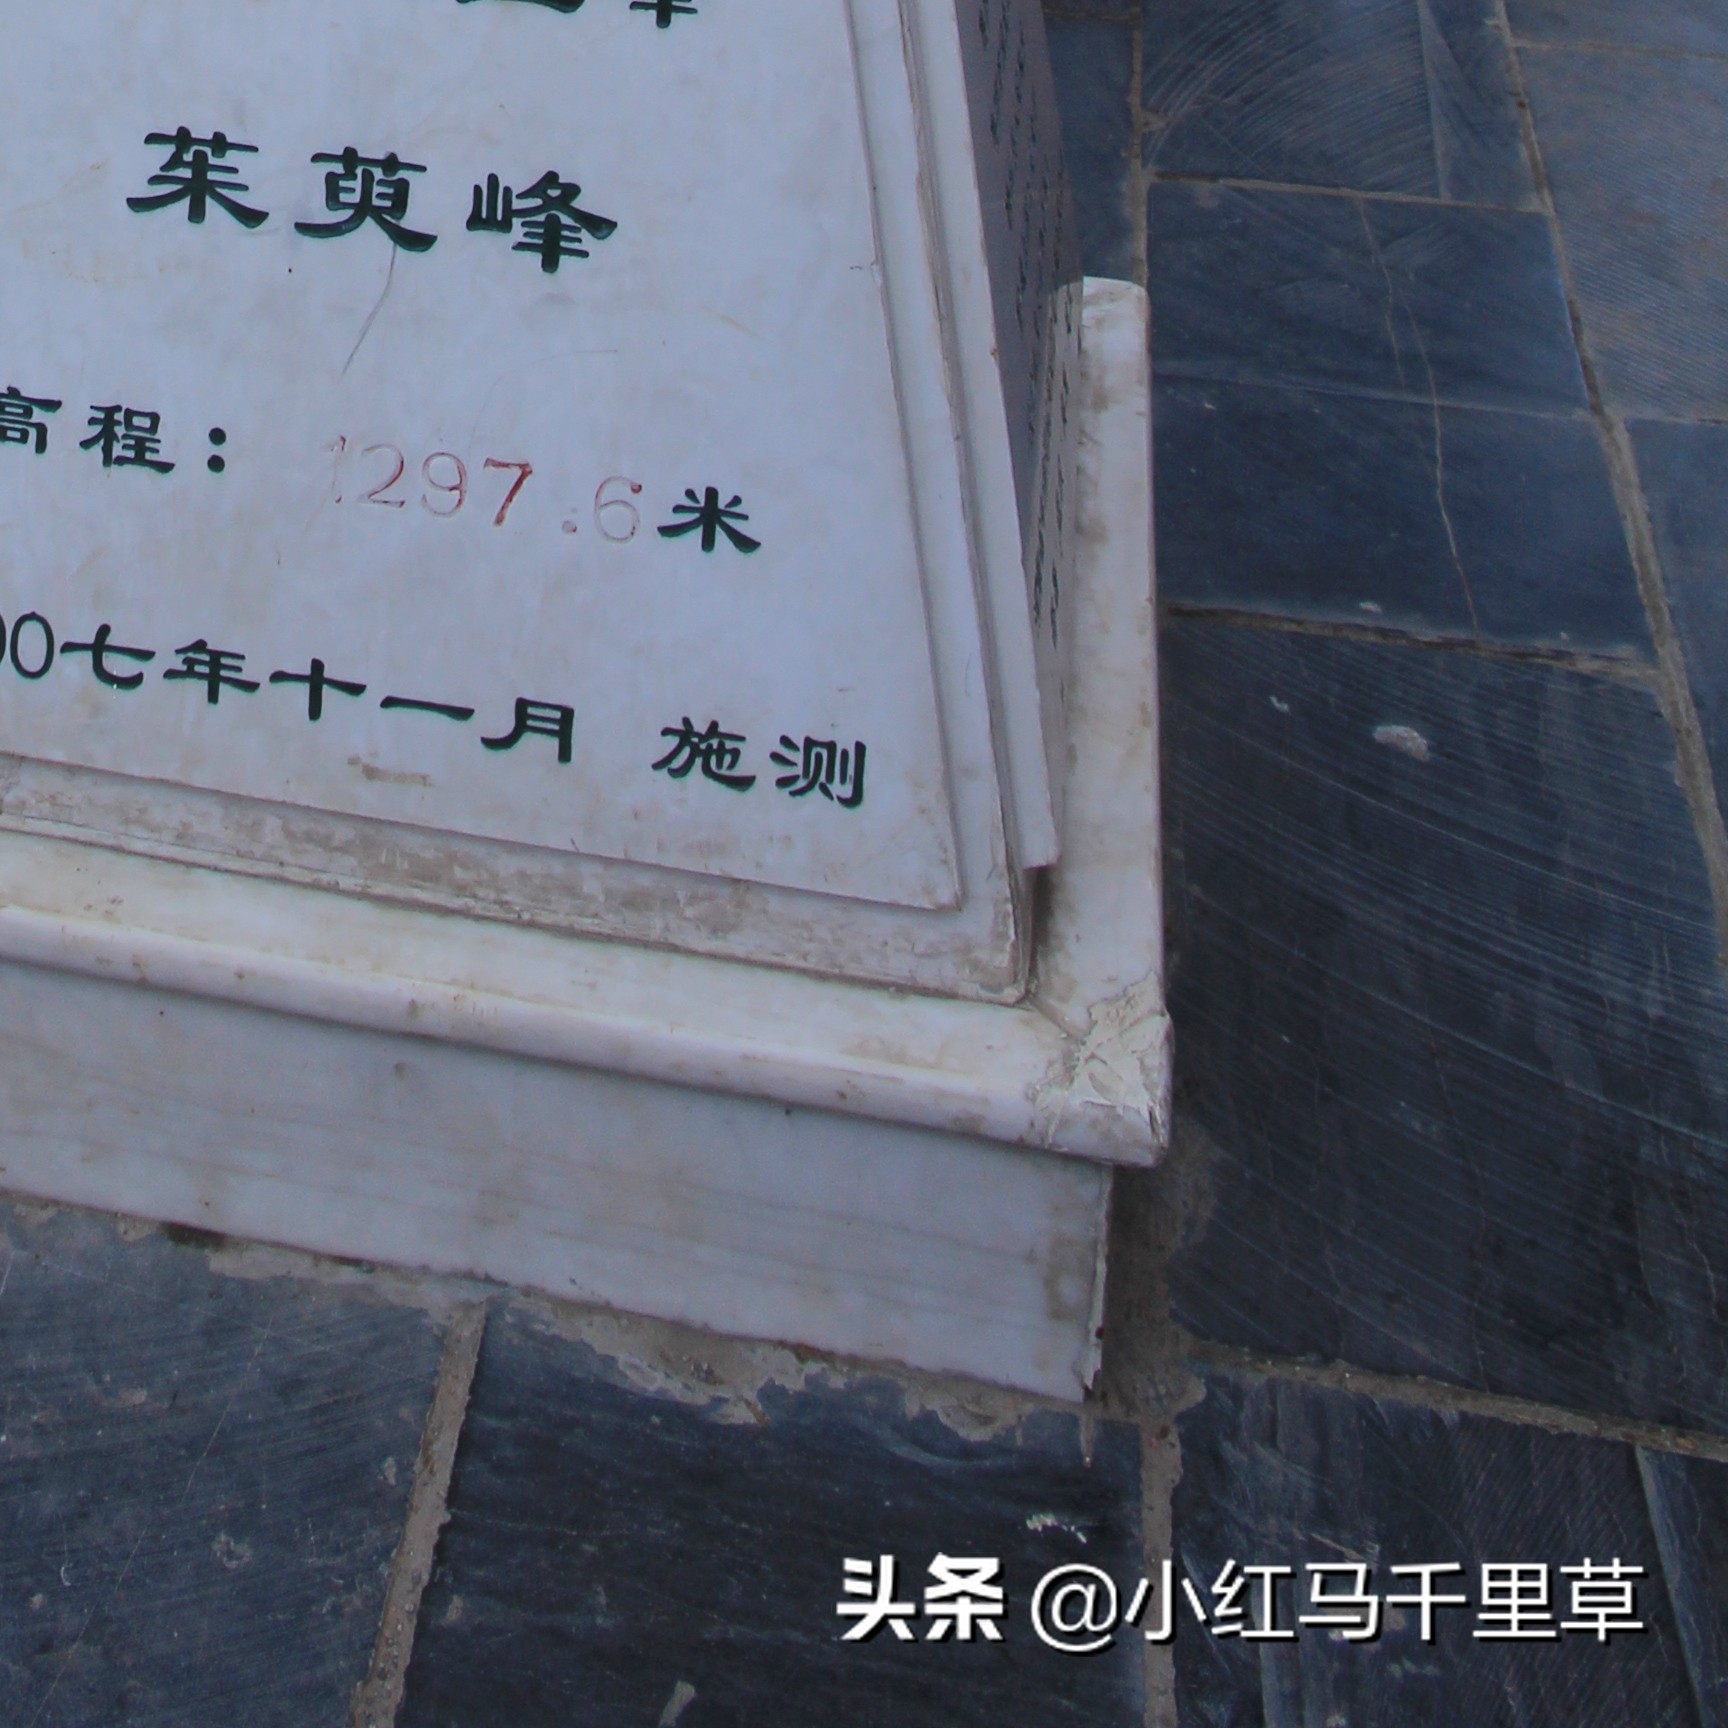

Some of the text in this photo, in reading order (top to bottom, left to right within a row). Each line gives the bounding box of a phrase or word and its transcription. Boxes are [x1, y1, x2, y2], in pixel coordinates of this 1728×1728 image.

[126, 126, 618, 274] 茱萸峰
[651, 716, 869, 809] 施测
